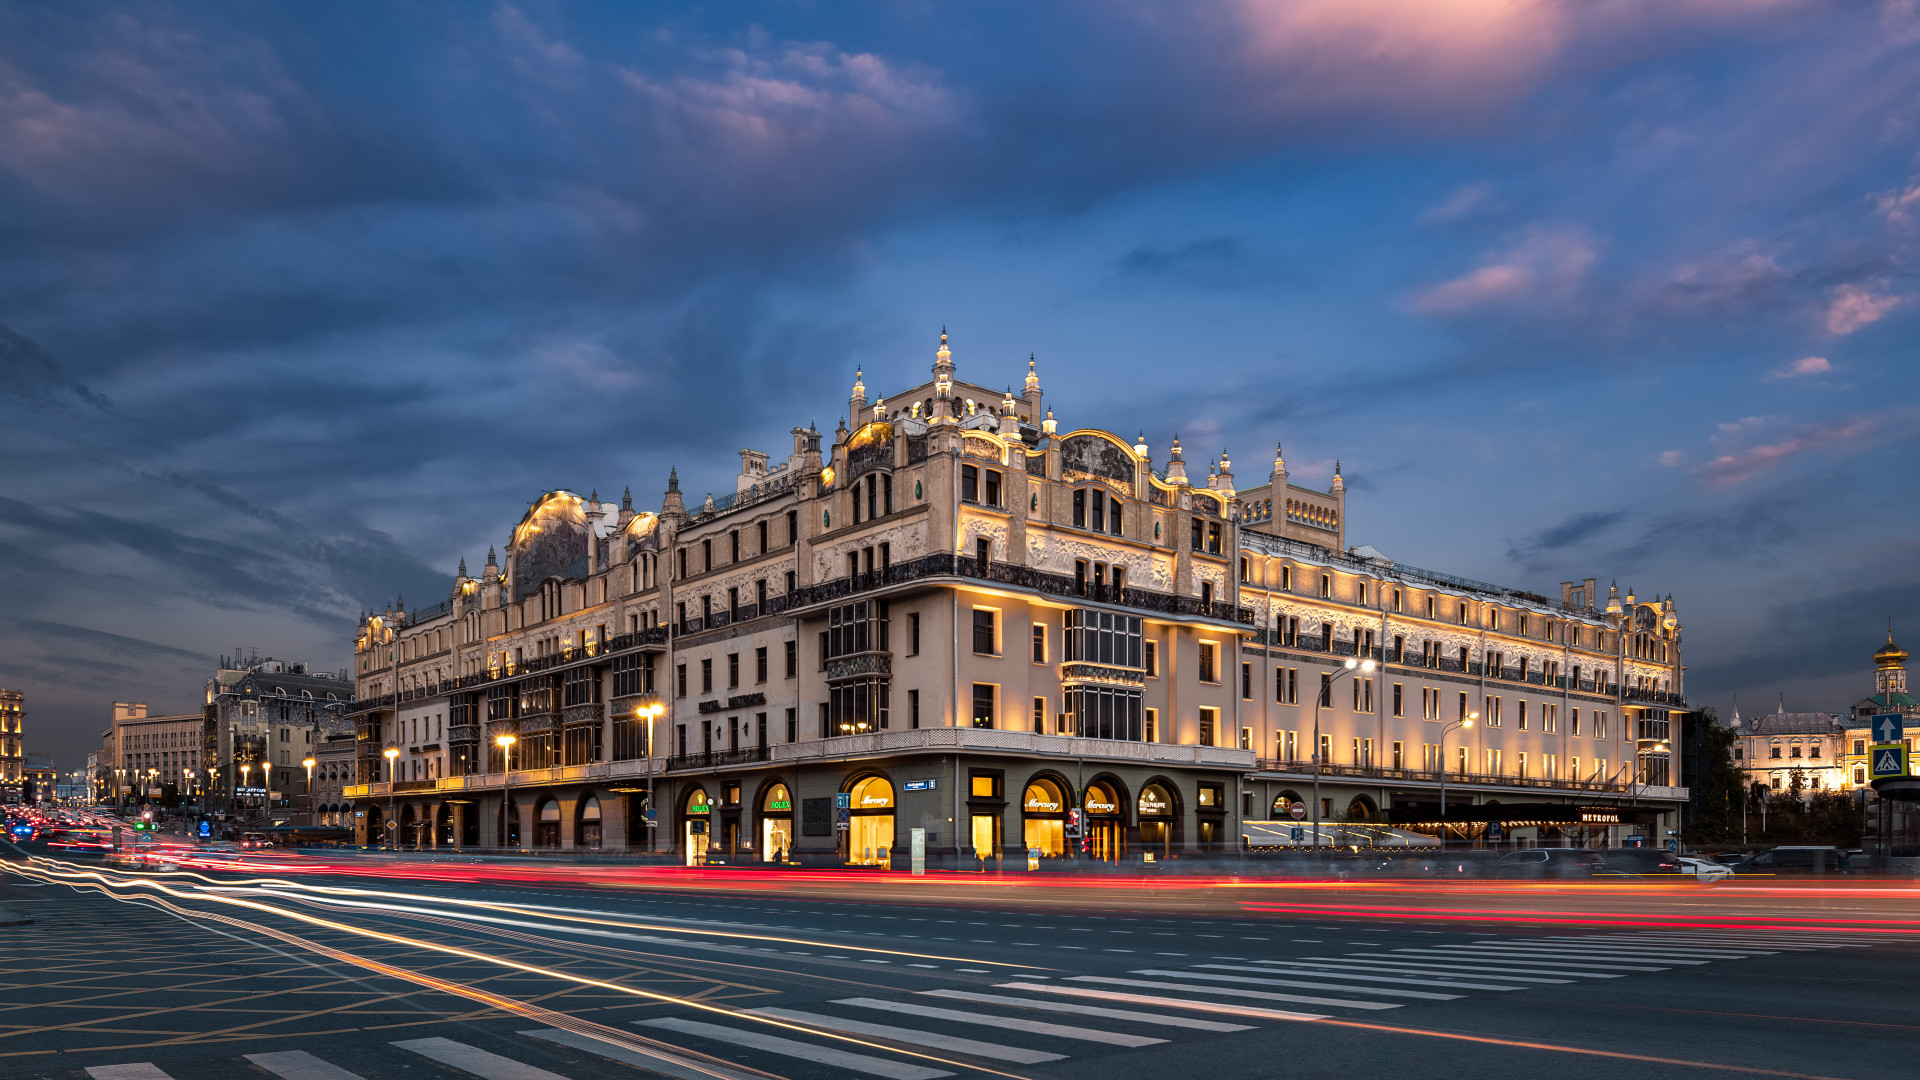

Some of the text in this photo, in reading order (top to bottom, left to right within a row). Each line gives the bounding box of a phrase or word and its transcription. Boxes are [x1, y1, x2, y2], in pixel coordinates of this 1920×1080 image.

[861, 795, 888, 806] Mercury
[1025, 798, 1059, 811] Mercury
[1085, 799, 1115, 811] Mercury
[1582, 813, 1620, 823] METROPOL
